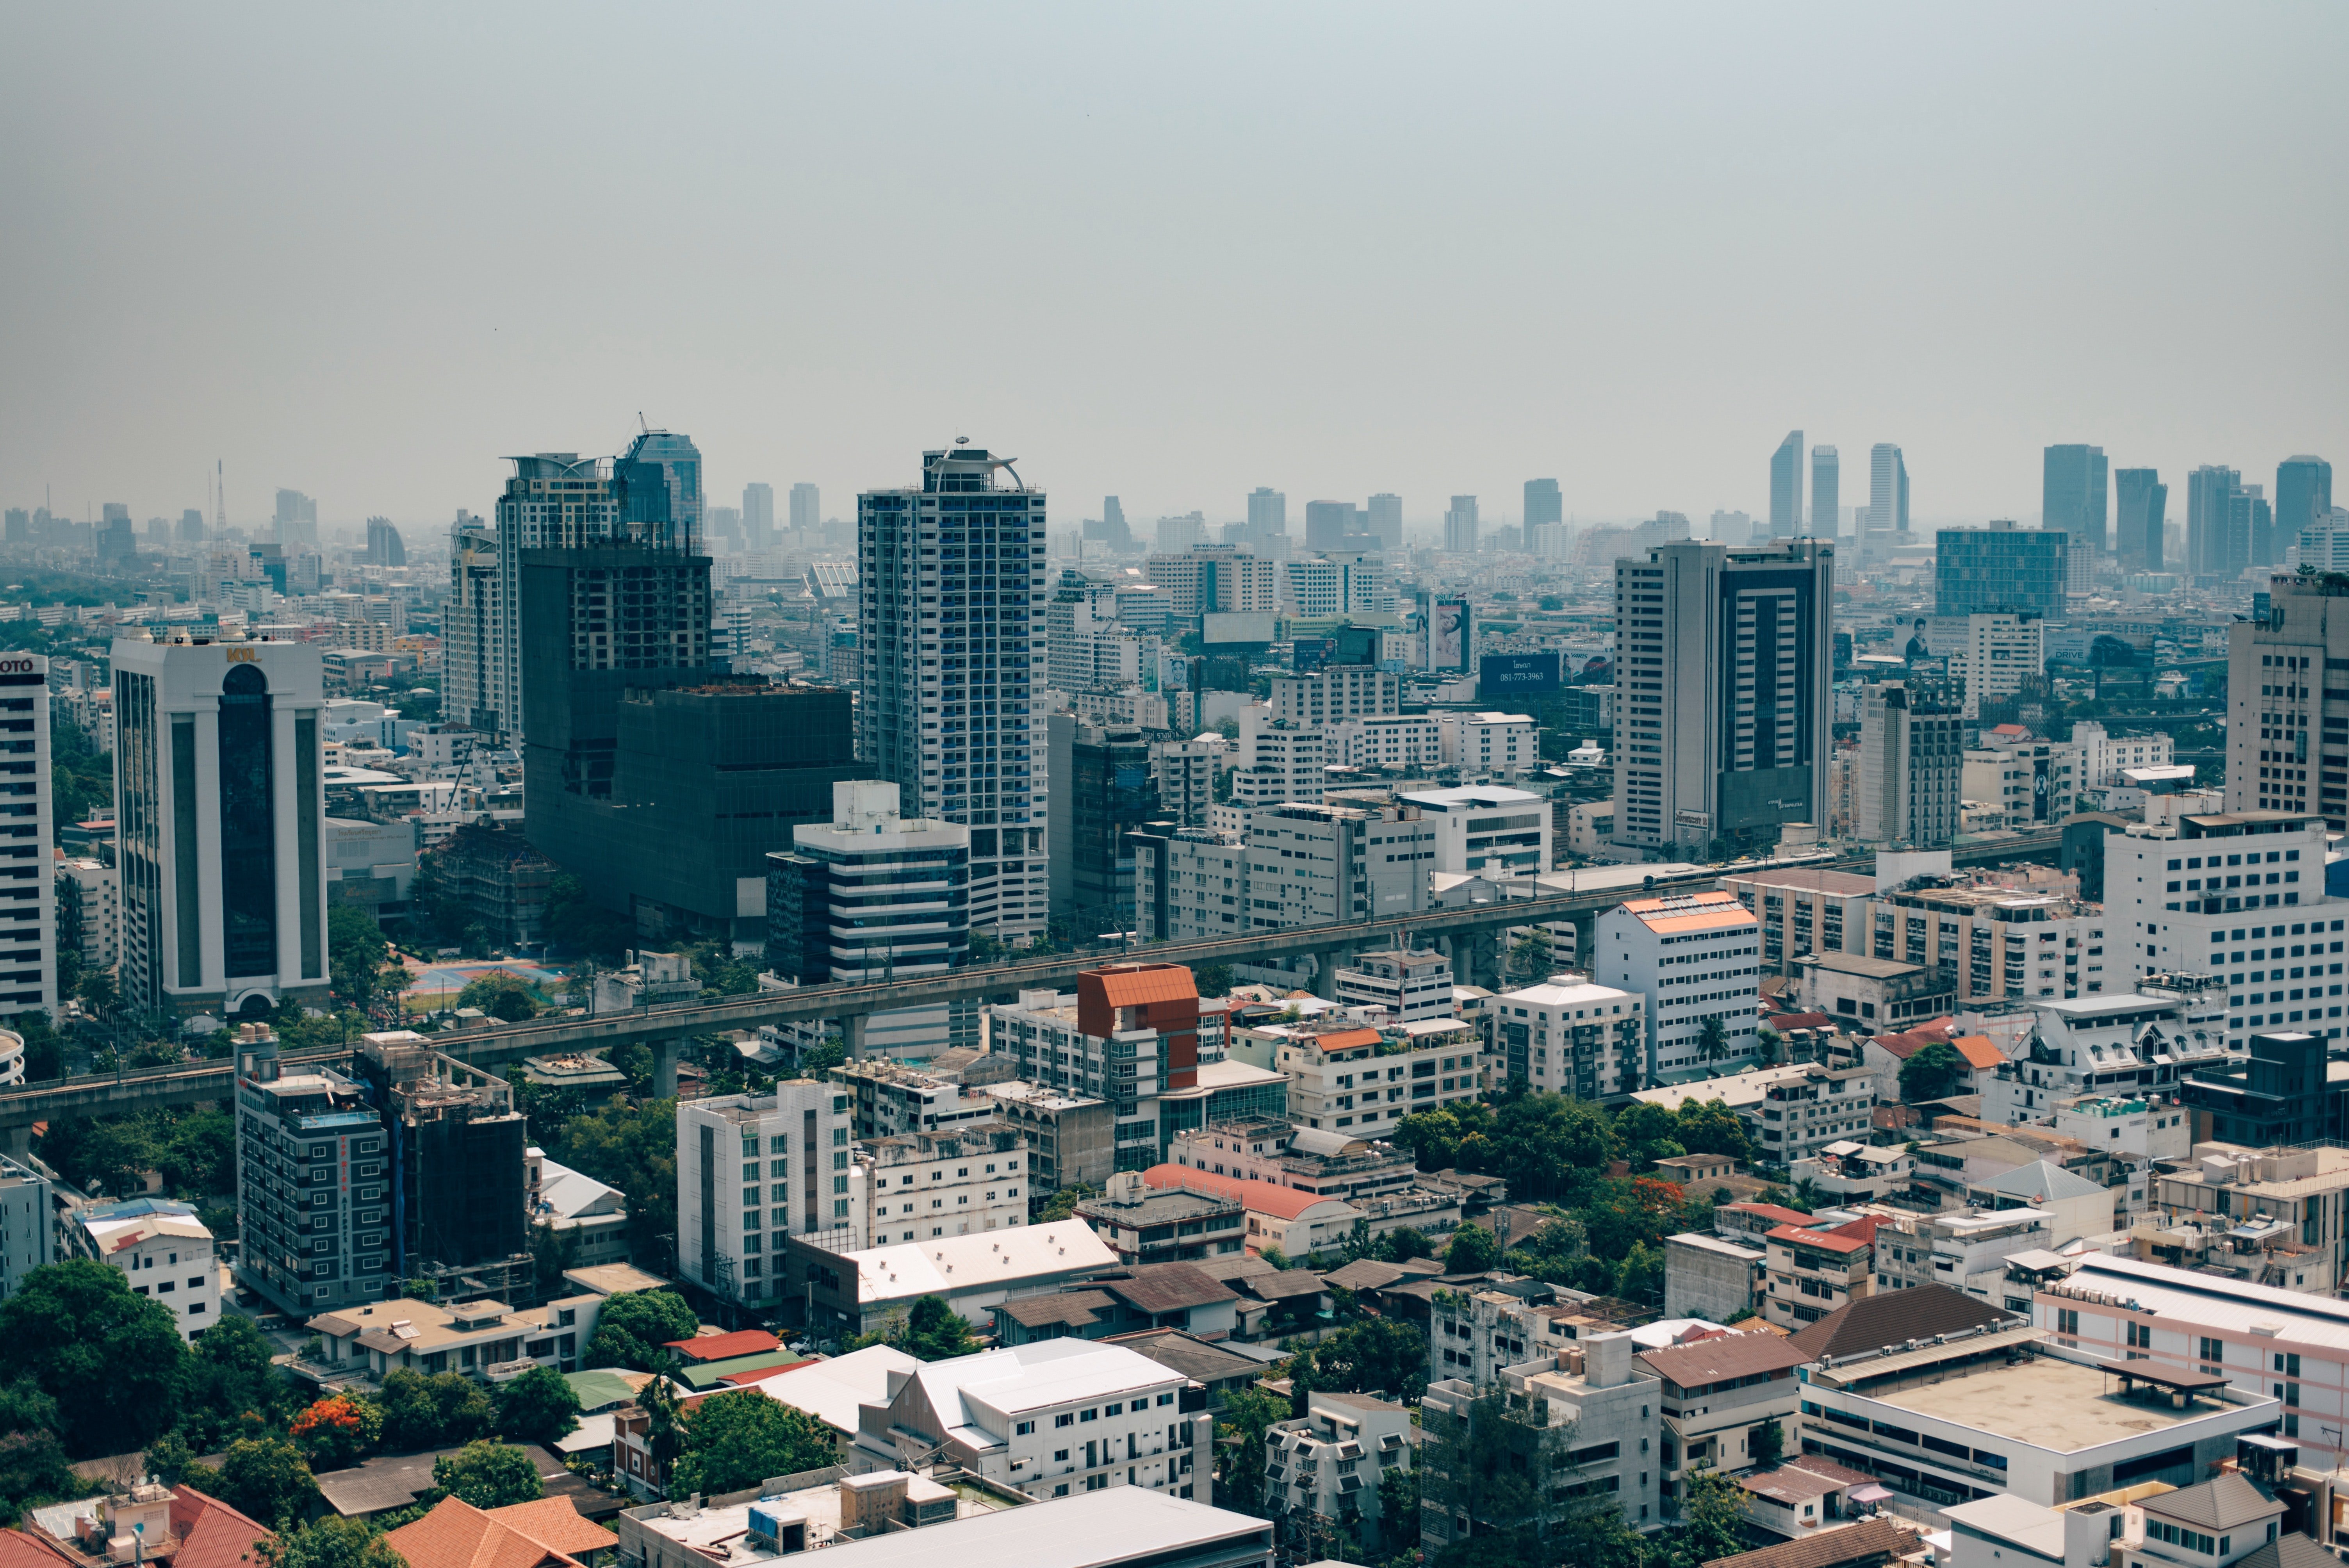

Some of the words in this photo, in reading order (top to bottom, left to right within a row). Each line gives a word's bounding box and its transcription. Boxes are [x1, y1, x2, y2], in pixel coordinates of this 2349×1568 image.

[227, 648, 262, 662] KSL
[1513, 660, 1531, 668] โฆษณา
[1501, 672, 1543, 681] 081-773-3963
